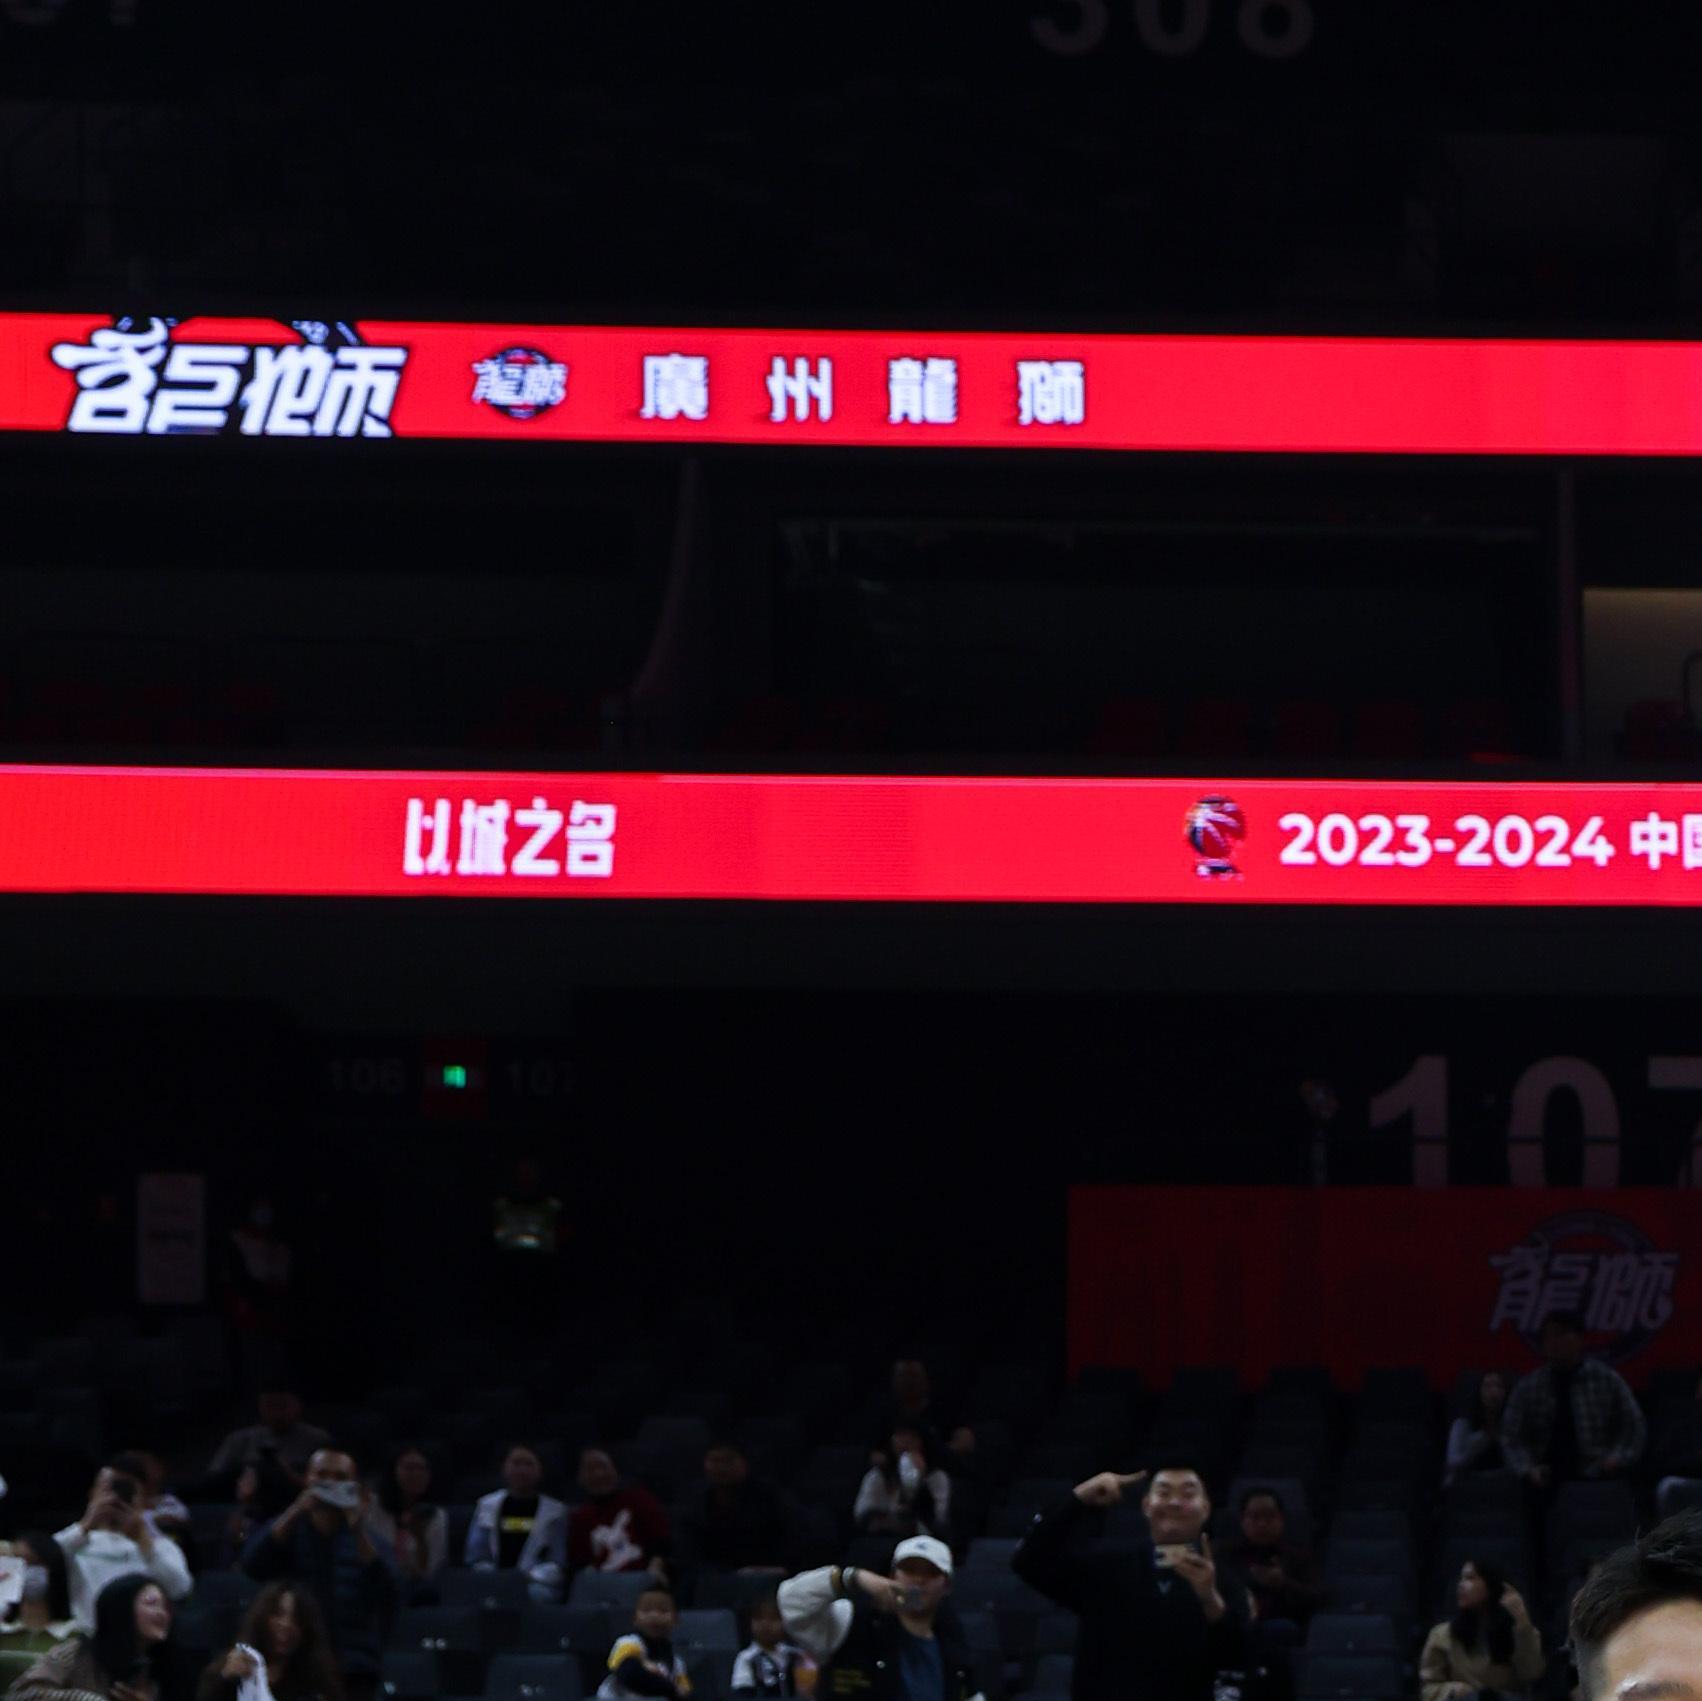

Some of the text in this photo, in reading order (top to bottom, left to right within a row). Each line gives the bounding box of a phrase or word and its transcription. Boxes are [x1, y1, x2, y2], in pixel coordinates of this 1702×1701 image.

[402, 796, 618, 878] 以城之名
[1279, 812, 1616, 868] 2023-2024
